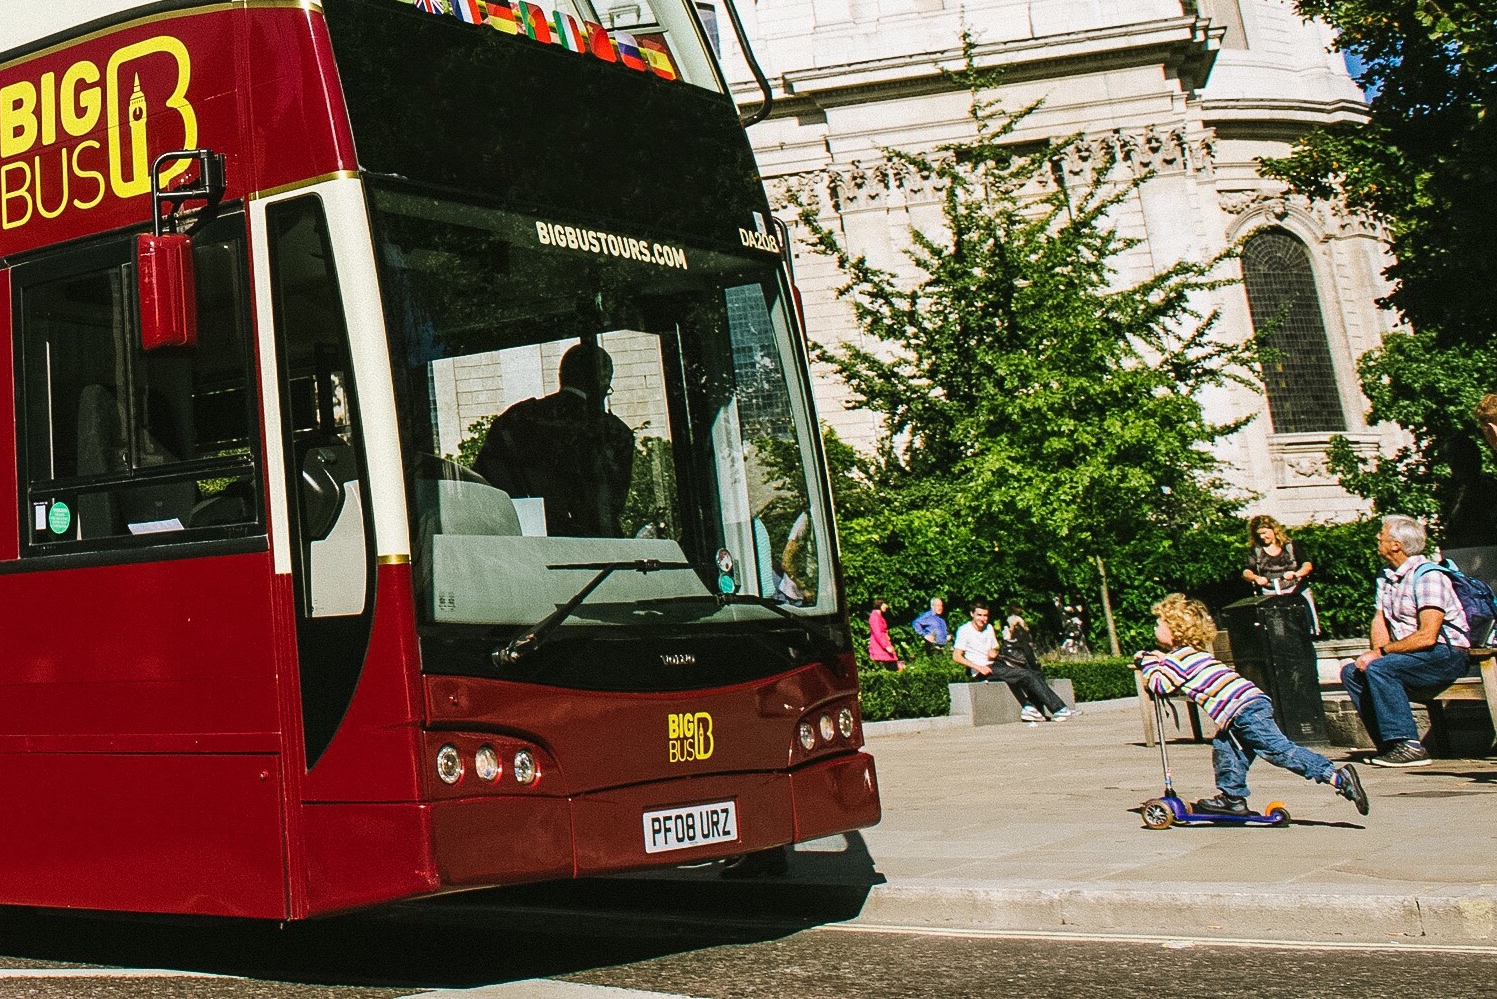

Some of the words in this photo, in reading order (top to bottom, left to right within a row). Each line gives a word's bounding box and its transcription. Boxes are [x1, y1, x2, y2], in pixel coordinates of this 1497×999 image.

[0, 60, 102, 158] BIG
[0, 140, 106, 230] BUS
[536, 221, 688, 270] BIGBUSTOURS.COM
[738, 228, 780, 254] DA208
[668, 712, 694, 739] BIG
[669, 738, 694, 762] BUS
[651, 812, 696, 847] PF08
[700, 808, 731, 839] URZ
